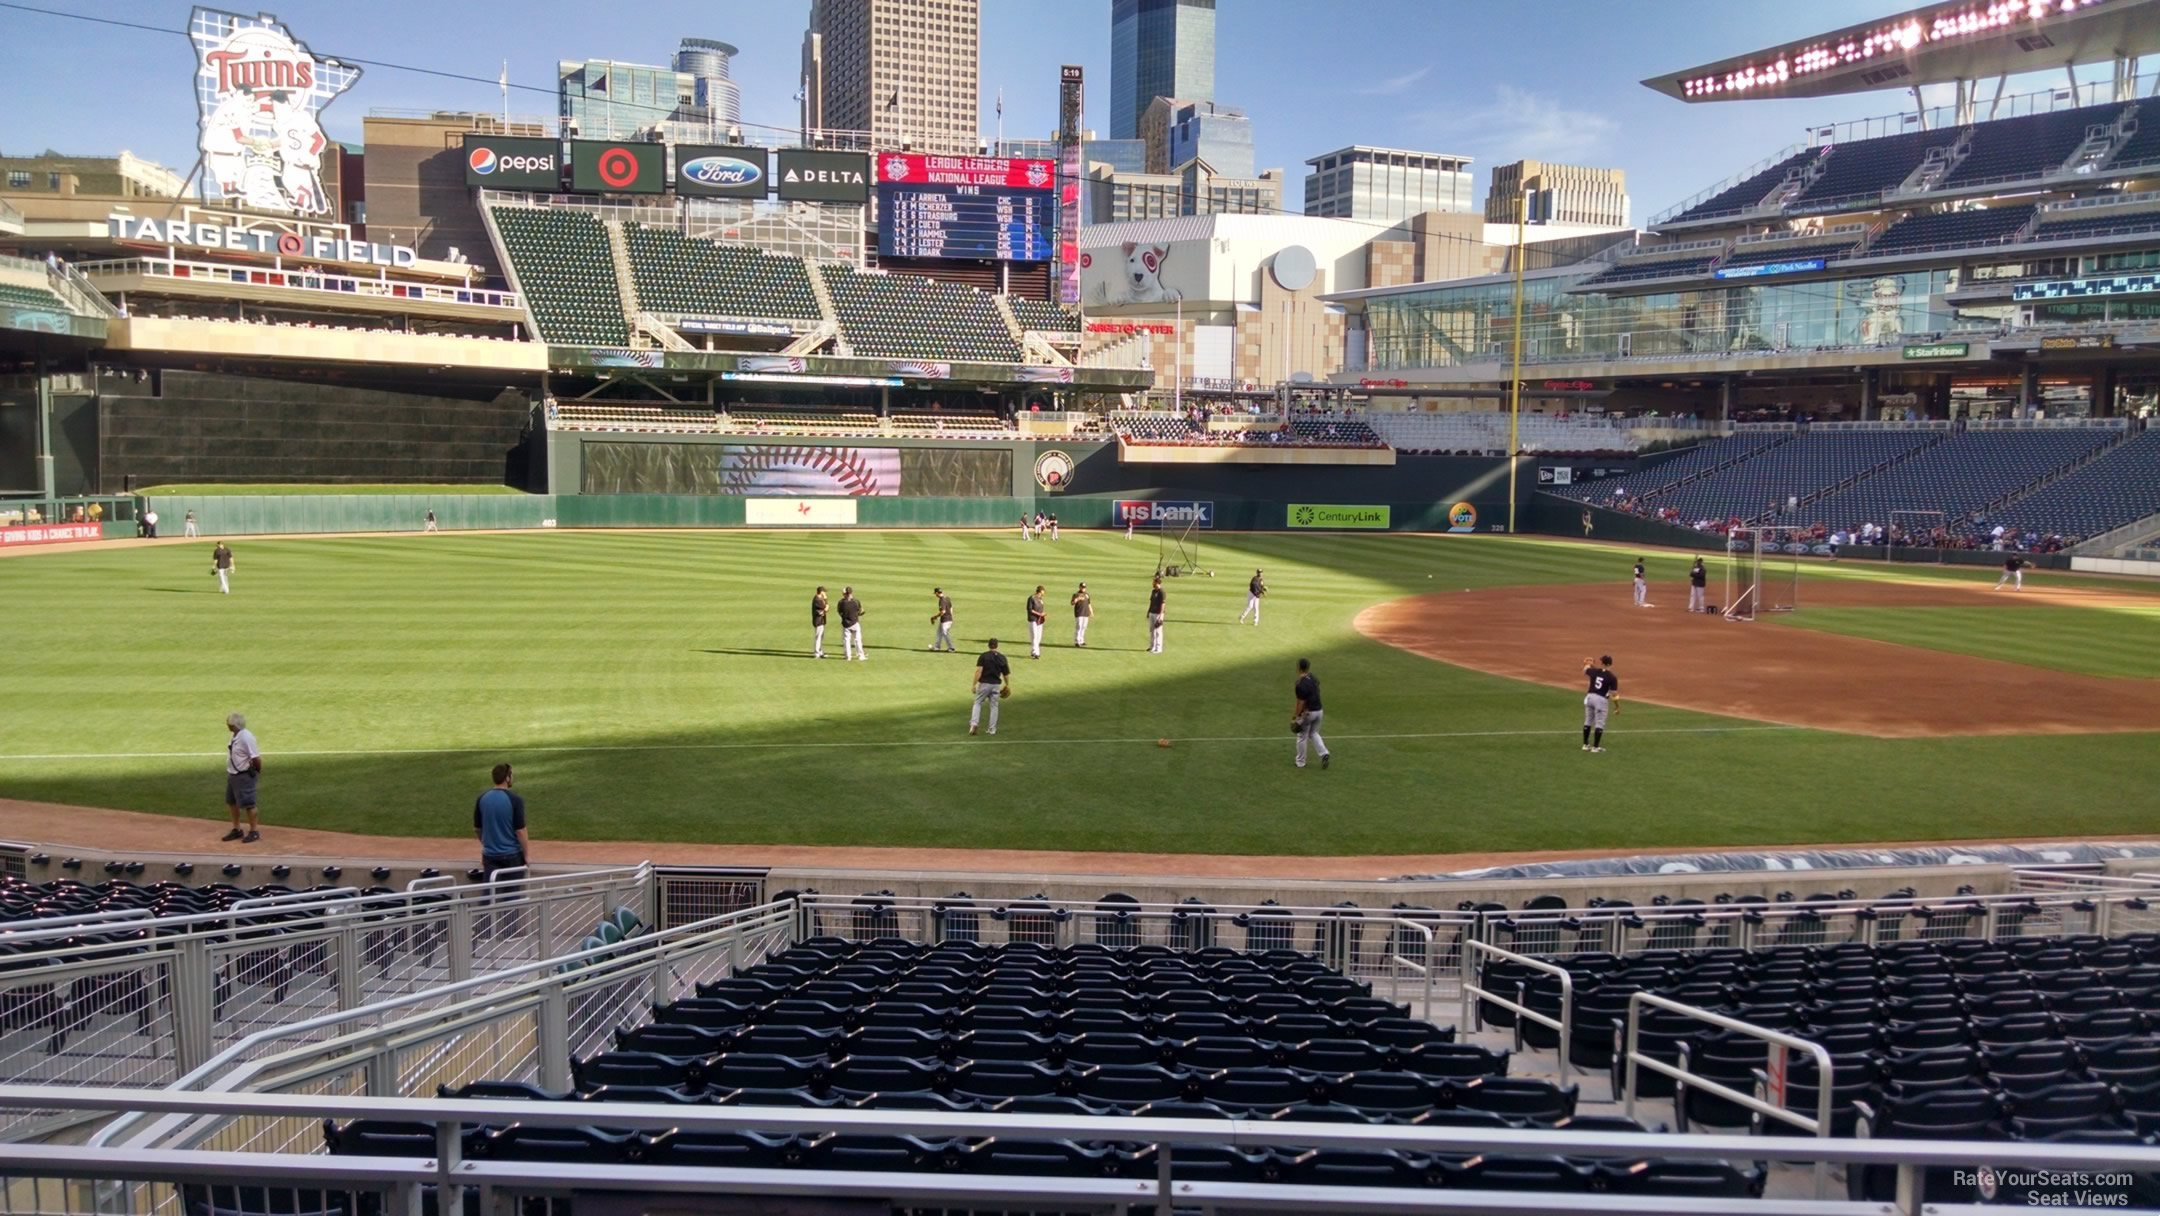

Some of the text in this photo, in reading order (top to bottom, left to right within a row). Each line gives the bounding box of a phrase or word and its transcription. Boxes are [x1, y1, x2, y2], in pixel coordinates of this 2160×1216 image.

[206, 48, 313, 93] Twins
[1063, 68, 1080, 77] 5:19
[500, 153, 556, 174] pepsi
[925, 156, 1010, 172] LEAGUE LEADERS
[696, 159, 745, 184] Ford
[804, 169, 864, 184] DELTA
[928, 172, 1007, 186] NATIONAL LEAGUE
[956, 185, 980, 195] WINS
[918, 195, 946, 203] ARRIETA
[998, 197, 1012, 205] CHC
[918, 203, 952, 212] SCHERZER
[996, 206, 1012, 214] WSH
[918, 212, 958, 220] STRASBURG
[996, 215, 1012, 223] WSH
[918, 221, 940, 229] CUETO
[1000, 223, 1008, 231] SF
[109, 213, 417, 267] TARGET FIELD
[918, 229, 948, 238] HAMMEL
[998, 232, 1012, 240] CHC
[918, 238, 944, 246] LESTER
[998, 240, 1012, 248] CHC
[918, 247, 942, 255] ROARK
[996, 250, 1012, 258] WSH
[2086, 287, 2093, 295] C
[2100, 286, 2112, 294] 32
[2141, 283, 2153, 291] 25
[758, 324, 790, 335] Ballpark
[1915, 346, 1964, 358] StarTribune
[1122, 502, 1208, 521] us bank
[1318, 511, 1382, 523] CenturyLink
[1453, 514, 1473, 522] VOTE
[43, 529, 48, 540] A
[49, 528, 74, 540] CHANCE
[74, 527, 83, 538] TO
[1594, 676, 1604, 690] 5
